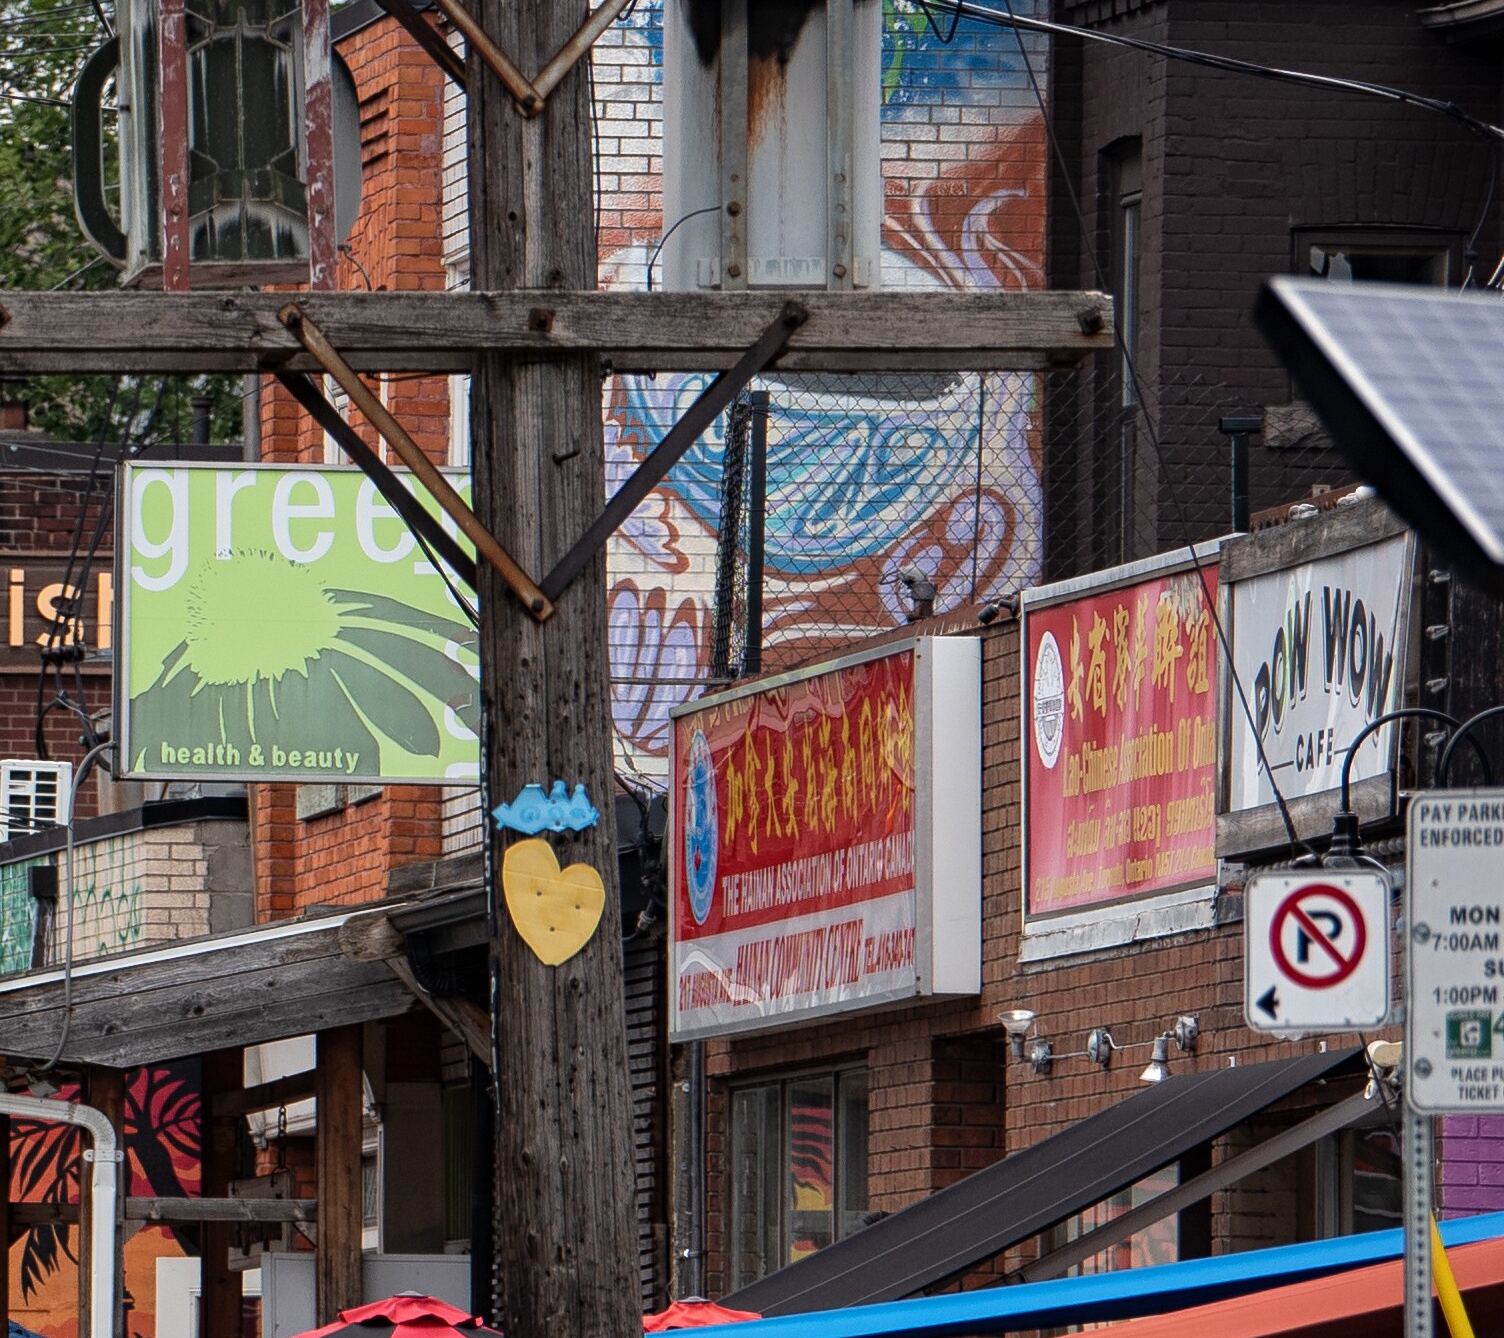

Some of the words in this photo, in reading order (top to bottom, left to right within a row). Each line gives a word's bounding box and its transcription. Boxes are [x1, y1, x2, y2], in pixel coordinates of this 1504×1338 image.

[1254, 590, 1313, 775] POW
[1320, 586, 1394, 748] WOW
[161, 741, 240, 765] health
[248, 744, 265, 766] &
[272, 744, 360, 773] beauty
[1177, 718, 1193, 773] Of
[1295, 727, 1335, 773] CAFE
[1420, 803, 1454, 822] PAY
[722, 872, 740, 919] THE
[774, 852, 833, 907] ASSOCIATION
[834, 848, 846, 895] OF
[847, 837, 884, 891] ONTARIO
[1449, 907, 1500, 925] MON
[1433, 934, 1499, 951] 7:00AM
[1434, 986, 1497, 1005] 1:00PM
[1459, 1084, 1499, 1100] TICKET
